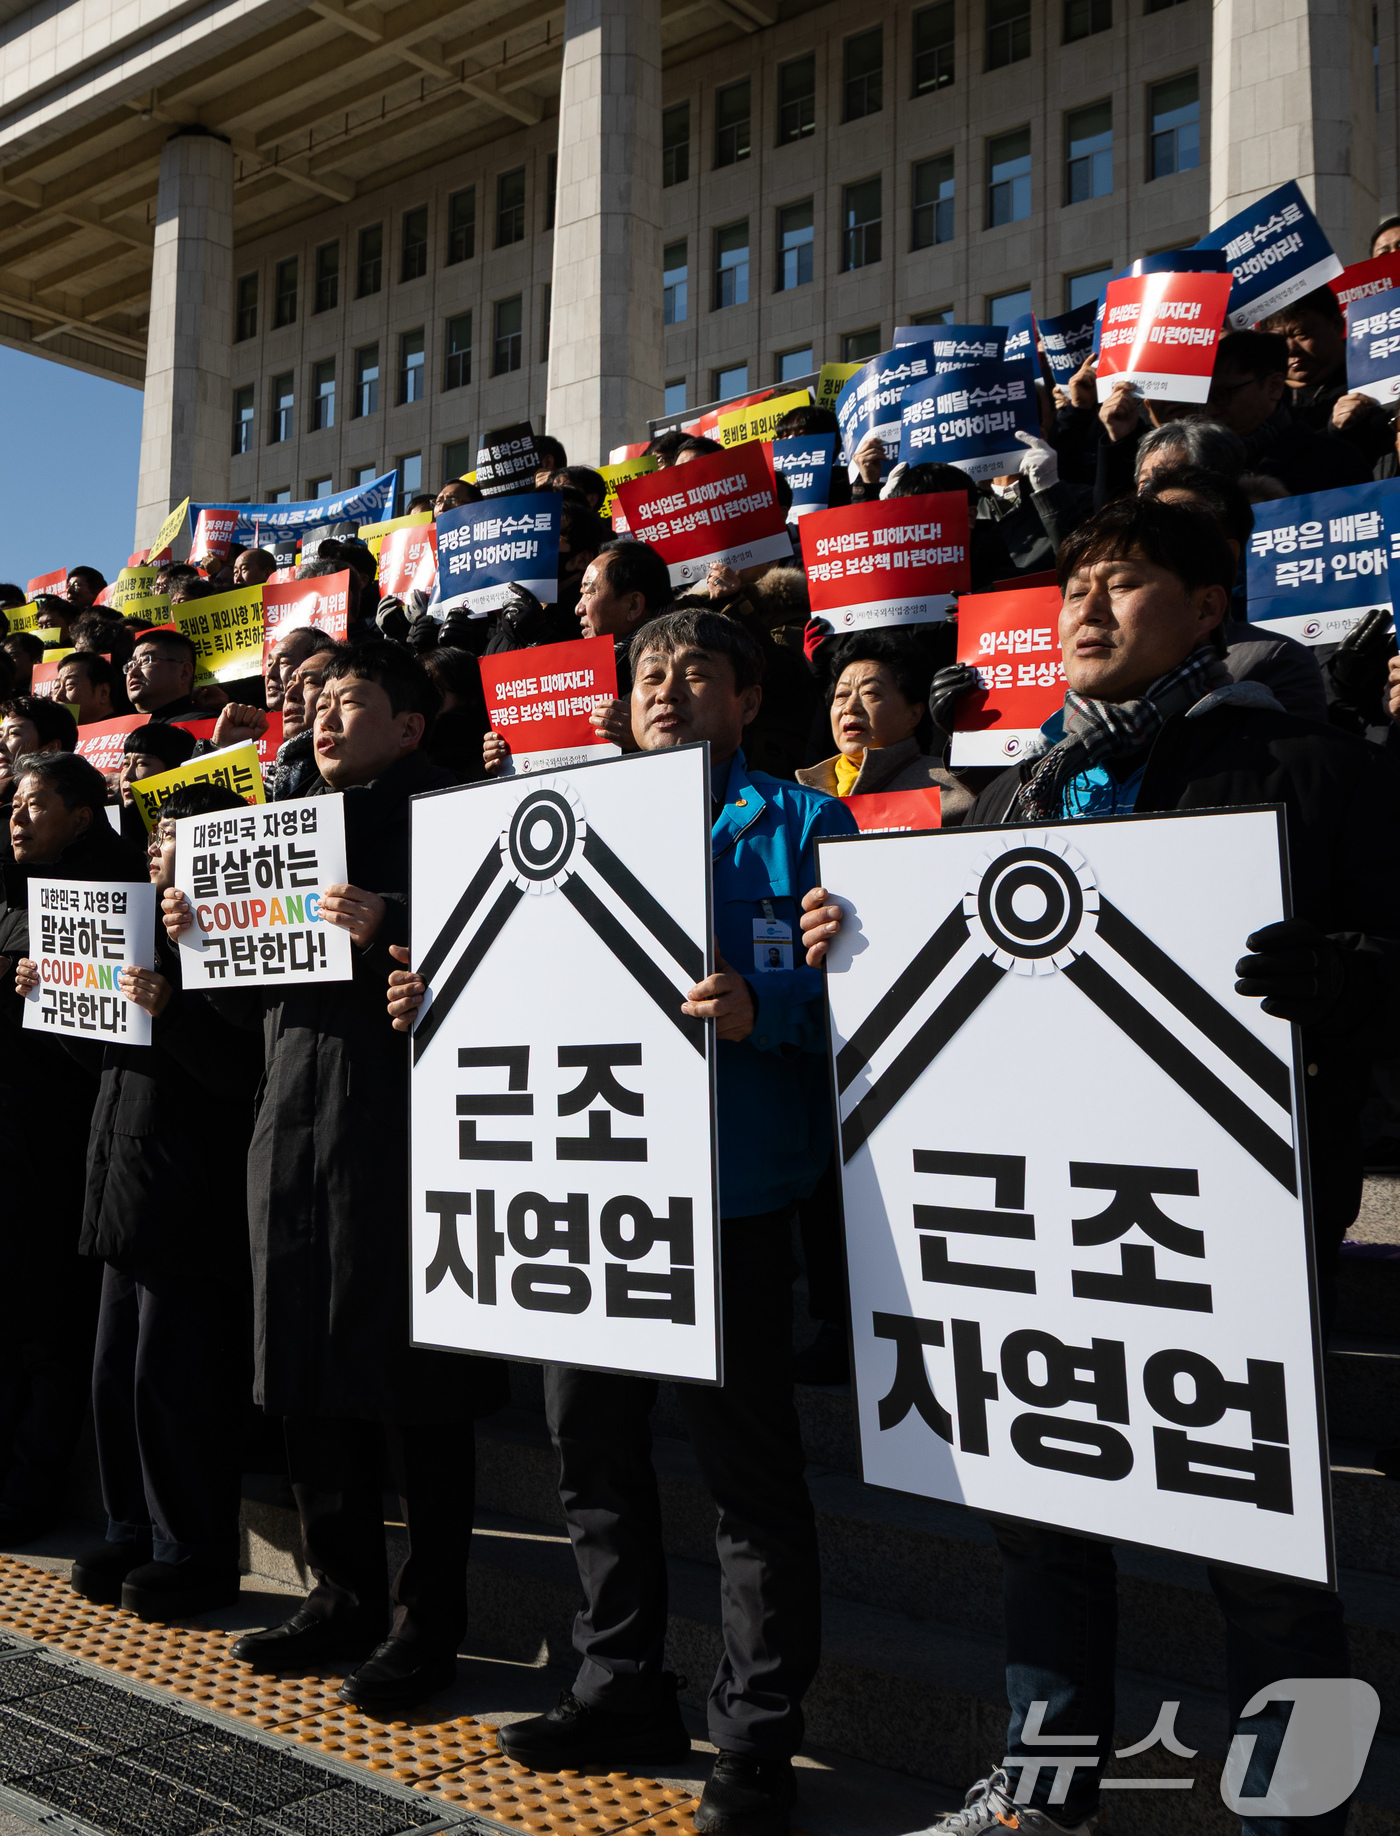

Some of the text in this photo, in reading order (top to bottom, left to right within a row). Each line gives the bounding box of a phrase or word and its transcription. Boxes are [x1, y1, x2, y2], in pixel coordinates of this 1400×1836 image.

[1232, 232, 1304, 284] 인하하라!
[1108, 302, 1141, 324] 외식업도
[1146, 301, 1202, 321] 해자다!
[1117, 327, 1149, 347] 보상
[1149, 326, 1216, 346] 마련하라!
[823, 379, 846, 395] 정비
[856, 358, 929, 401] 배달수수료
[902, 380, 1027, 427] 쿠팡은 배달수수료
[723, 422, 747, 445] 정비업
[909, 424, 937, 449] 즉각
[938, 410, 1016, 443] 인하하라!
[490, 436, 533, 461] 정착으로
[494, 451, 540, 477] 위협한다!
[327, 485, 393, 521] 파괴하는
[637, 492, 688, 521] 외식업도
[687, 473, 748, 505] 피해자다!
[438, 513, 552, 553] 쿠팡은 배달수수료
[634, 520, 672, 544] 쿠팡은
[670, 509, 711, 535] 보상책
[710, 490, 774, 523] 마련하라!
[1251, 511, 1384, 557] 쿠팡은 배달
[449, 551, 472, 575] 즉각
[473, 540, 538, 569] 인하하라!
[816, 523, 942, 557] 외식업도 피해자다!
[807, 546, 965, 583] 쿠팡은 보상책 마련하라!
[1275, 558, 1326, 588] 즉각
[155, 605, 169, 621] 개정
[180, 615, 210, 639] 정비업
[210, 605, 249, 631] 제외사항
[856, 604, 928, 620] (사)한국외식업중앙회
[214, 630, 233, 654] 즉시
[978, 627, 1053, 656] 외식업도
[495, 669, 594, 701] 외식업도 피해자다!
[490, 705, 520, 727] 쿠팡은
[520, 700, 556, 722] 보상책
[192, 807, 318, 848] 대한민국 자영업
[192, 842, 319, 899] 말살하는
[41, 888, 128, 914] 대한민국 자영업
[41, 915, 126, 960] 말살하는
[202, 930, 327, 979] 규탄한다!
[41, 988, 127, 1033] 규탄한다!
[456, 1043, 648, 1162] 근조
[912, 1149, 1214, 1314] 근조
[425, 1189, 696, 1326] 자영업
[872, 1311, 1295, 1516] 자영업
